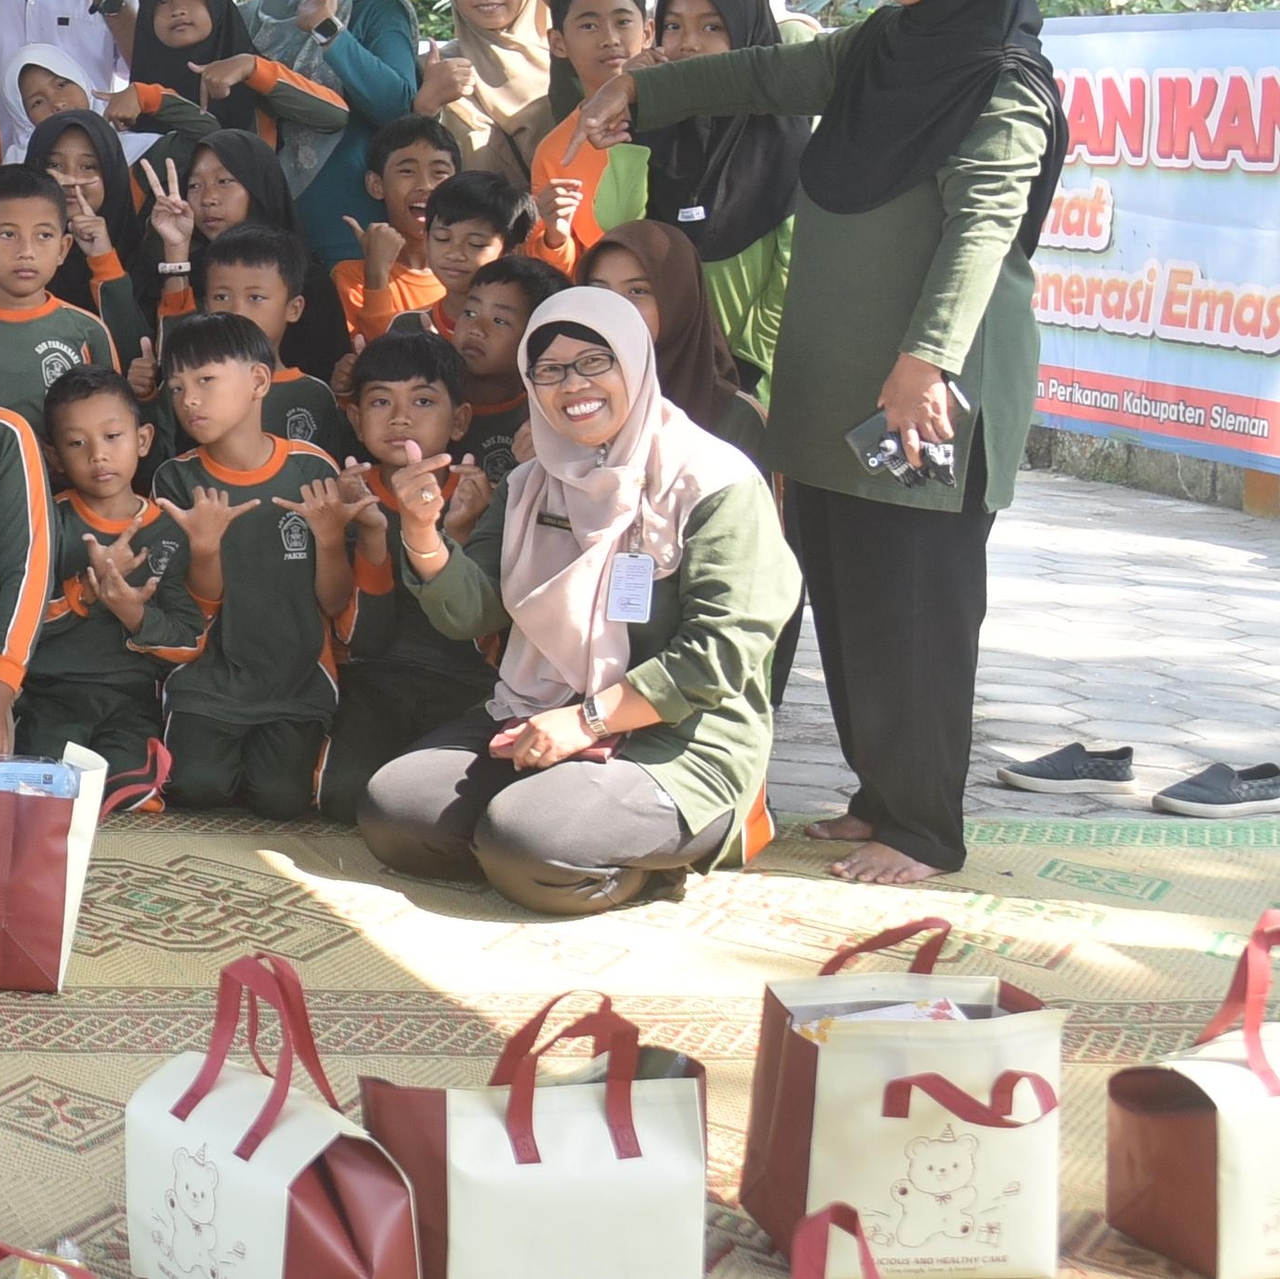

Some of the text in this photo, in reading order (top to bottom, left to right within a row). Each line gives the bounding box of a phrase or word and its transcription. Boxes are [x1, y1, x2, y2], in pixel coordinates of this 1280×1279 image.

[1048, 377, 1119, 412] Perikanan
[1122, 391, 1206, 427] Kabupaten
[1210, 404, 1269, 439] Sleman
